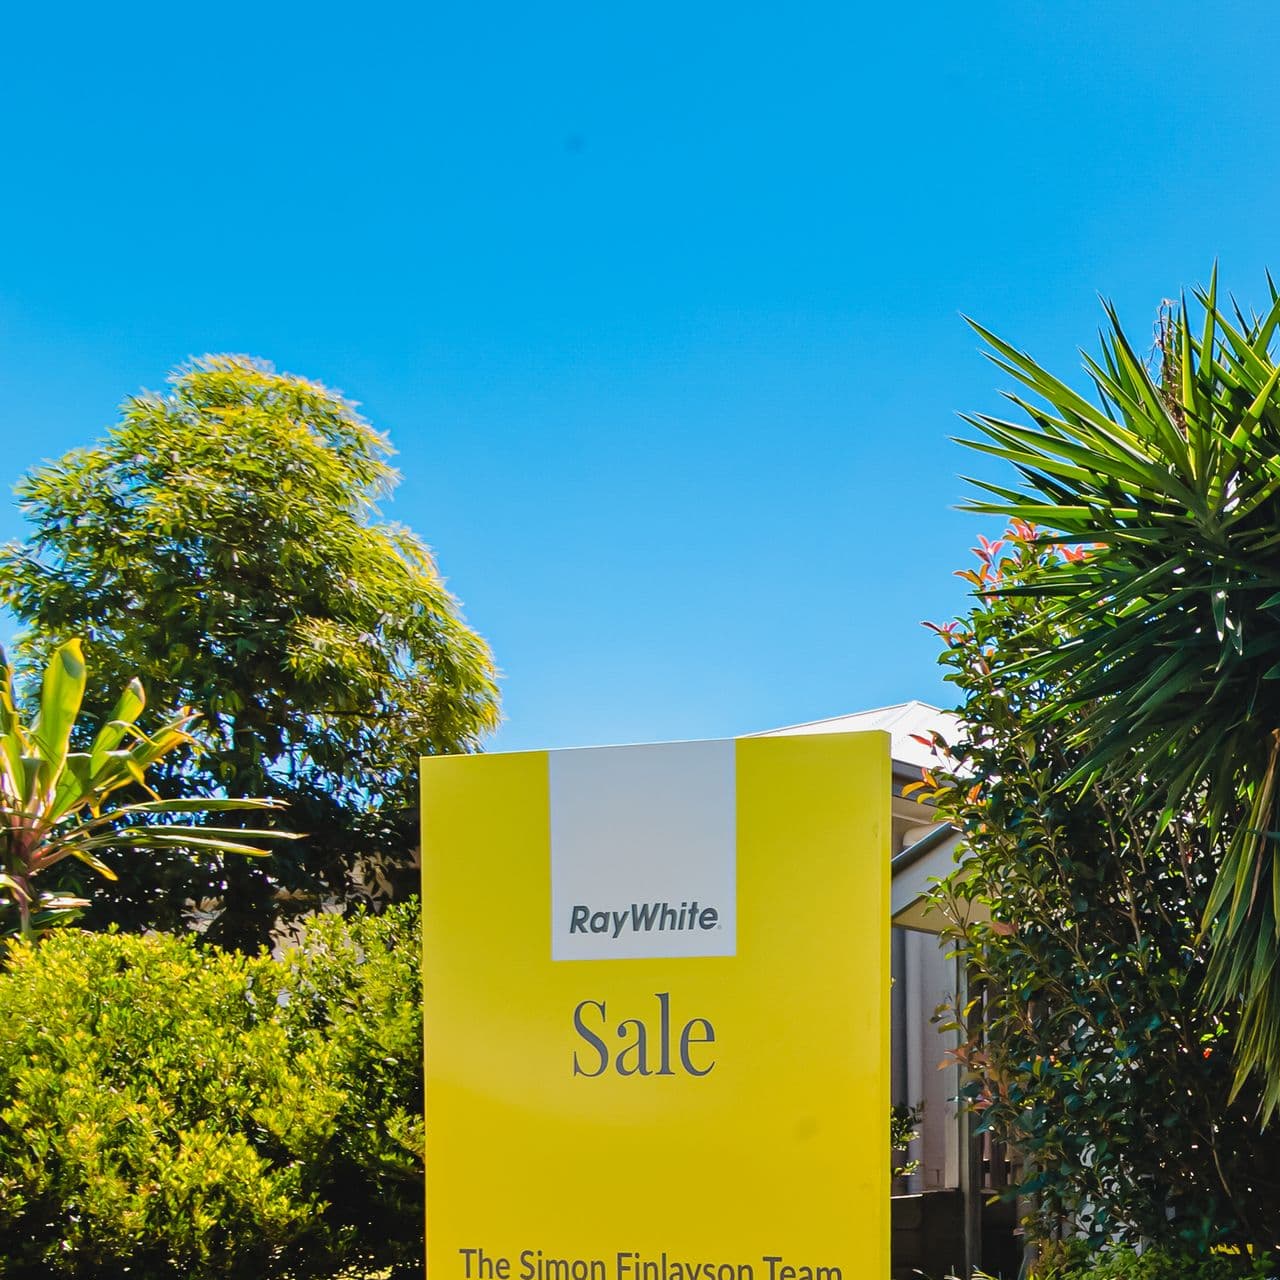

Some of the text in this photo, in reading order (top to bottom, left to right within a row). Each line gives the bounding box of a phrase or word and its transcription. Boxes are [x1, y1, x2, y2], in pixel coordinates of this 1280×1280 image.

[569, 901, 720, 939] RayWhite
[573, 991, 716, 1078] Sale
[458, 1247, 511, 1280] The
